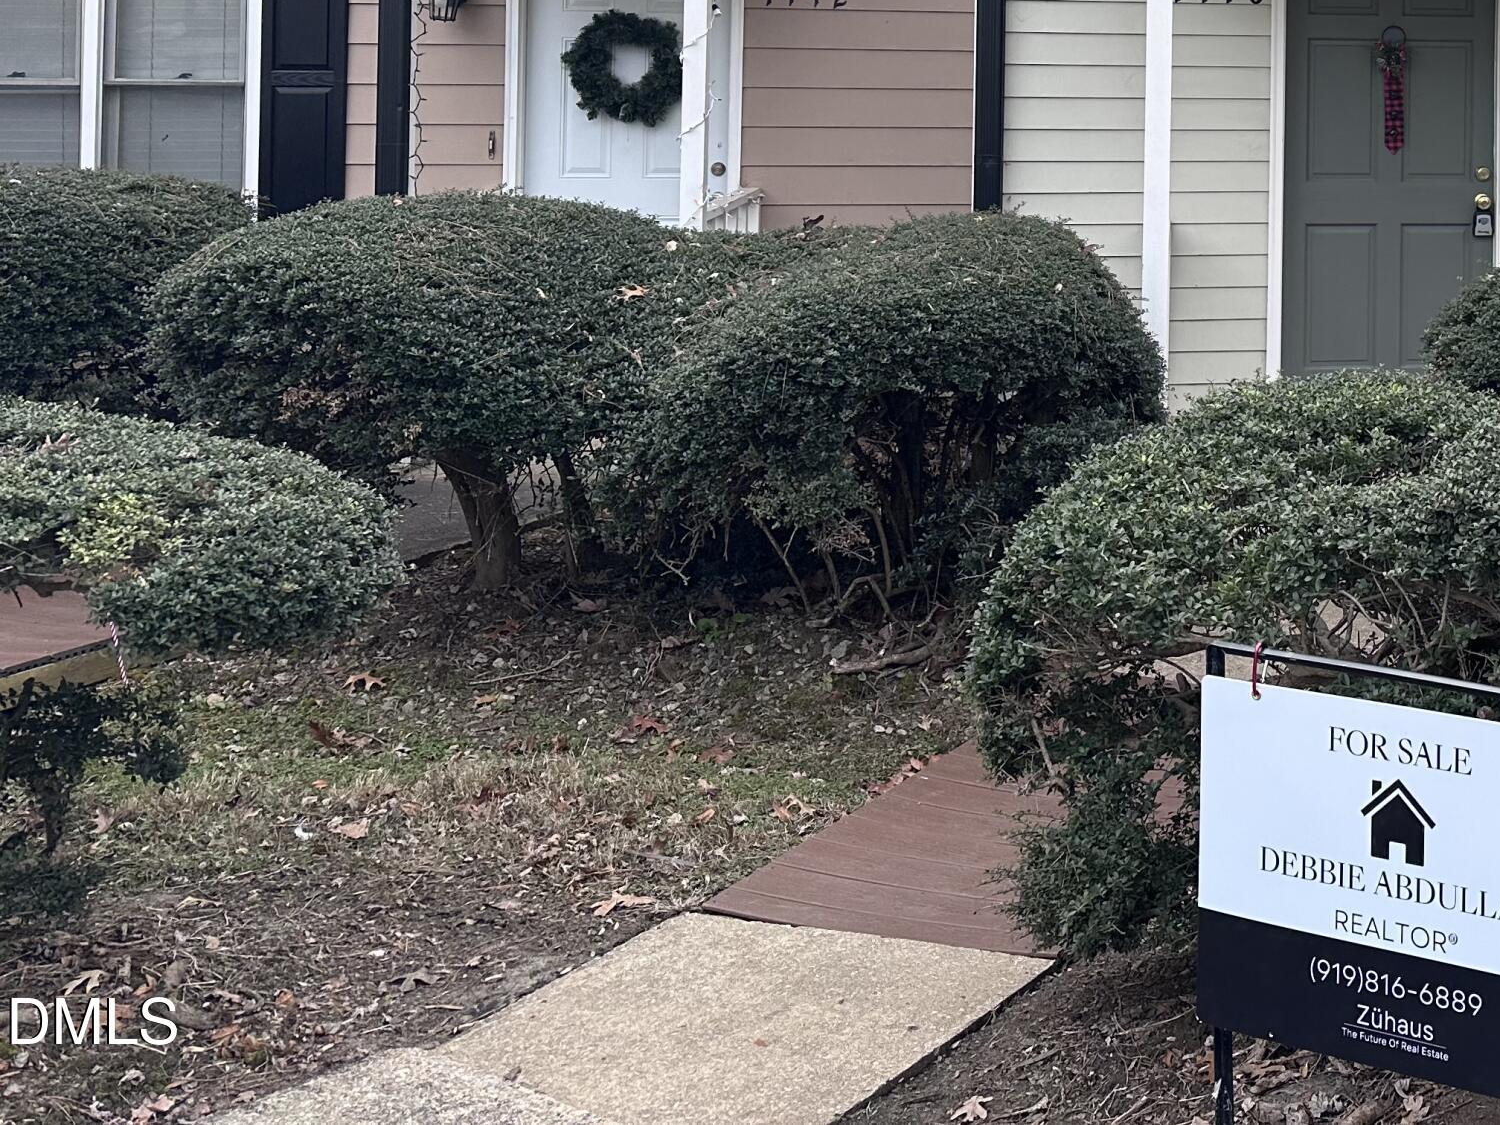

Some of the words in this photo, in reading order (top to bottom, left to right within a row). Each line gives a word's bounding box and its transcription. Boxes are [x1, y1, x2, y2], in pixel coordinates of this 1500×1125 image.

[1328, 726, 1390, 761] FOR
[1397, 737, 1473, 776] SALE
[1259, 845, 1366, 892] DEBBIE
[1310, 956, 1483, 1016] (919)816-6889
[1341, 1026, 1358, 1039] The
[1359, 1031, 1387, 1047] Future
[1388, 1038, 1400, 1049] Of
[1401, 1041, 1420, 1054] Real
[1421, 1046, 1449, 1061] Estate
[1356, 1003, 1434, 1041] Zühaus
